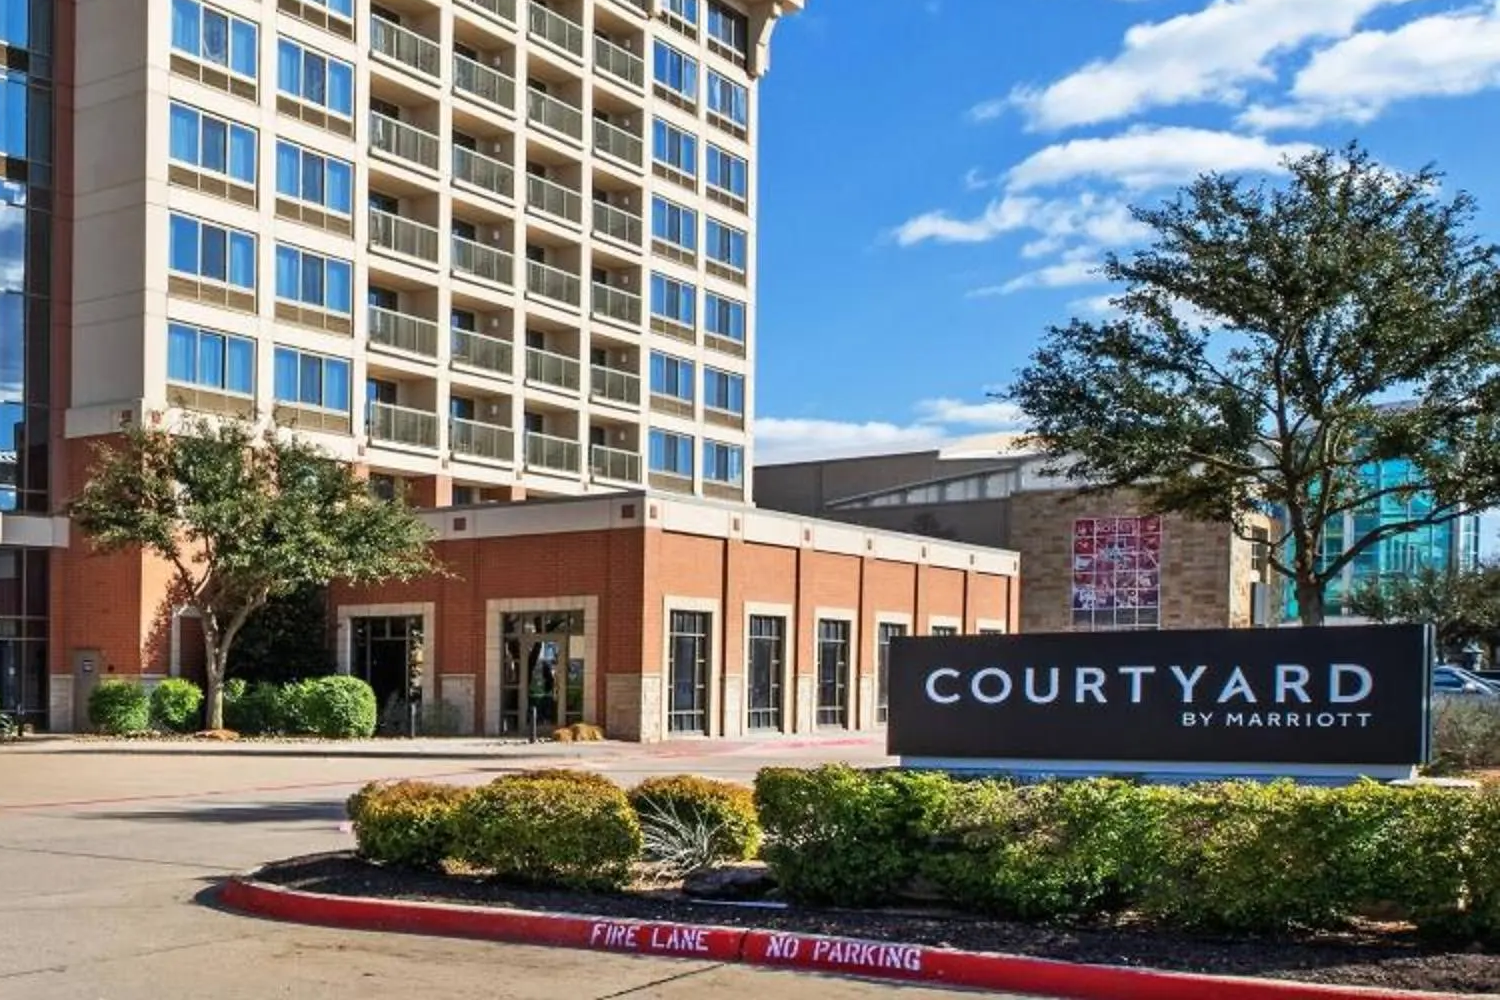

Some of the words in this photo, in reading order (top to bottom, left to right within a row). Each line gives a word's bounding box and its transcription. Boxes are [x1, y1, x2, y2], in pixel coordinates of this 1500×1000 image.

[925, 664, 1374, 704] COURTYARD
[1182, 712, 1214, 727] BY
[1225, 712, 1372, 727] MARRIOTT
[590, 923, 641, 947] FIRE
[651, 927, 709, 951] LANE
[765, 935, 799, 959] NO
[813, 940, 921, 971] PARKING
